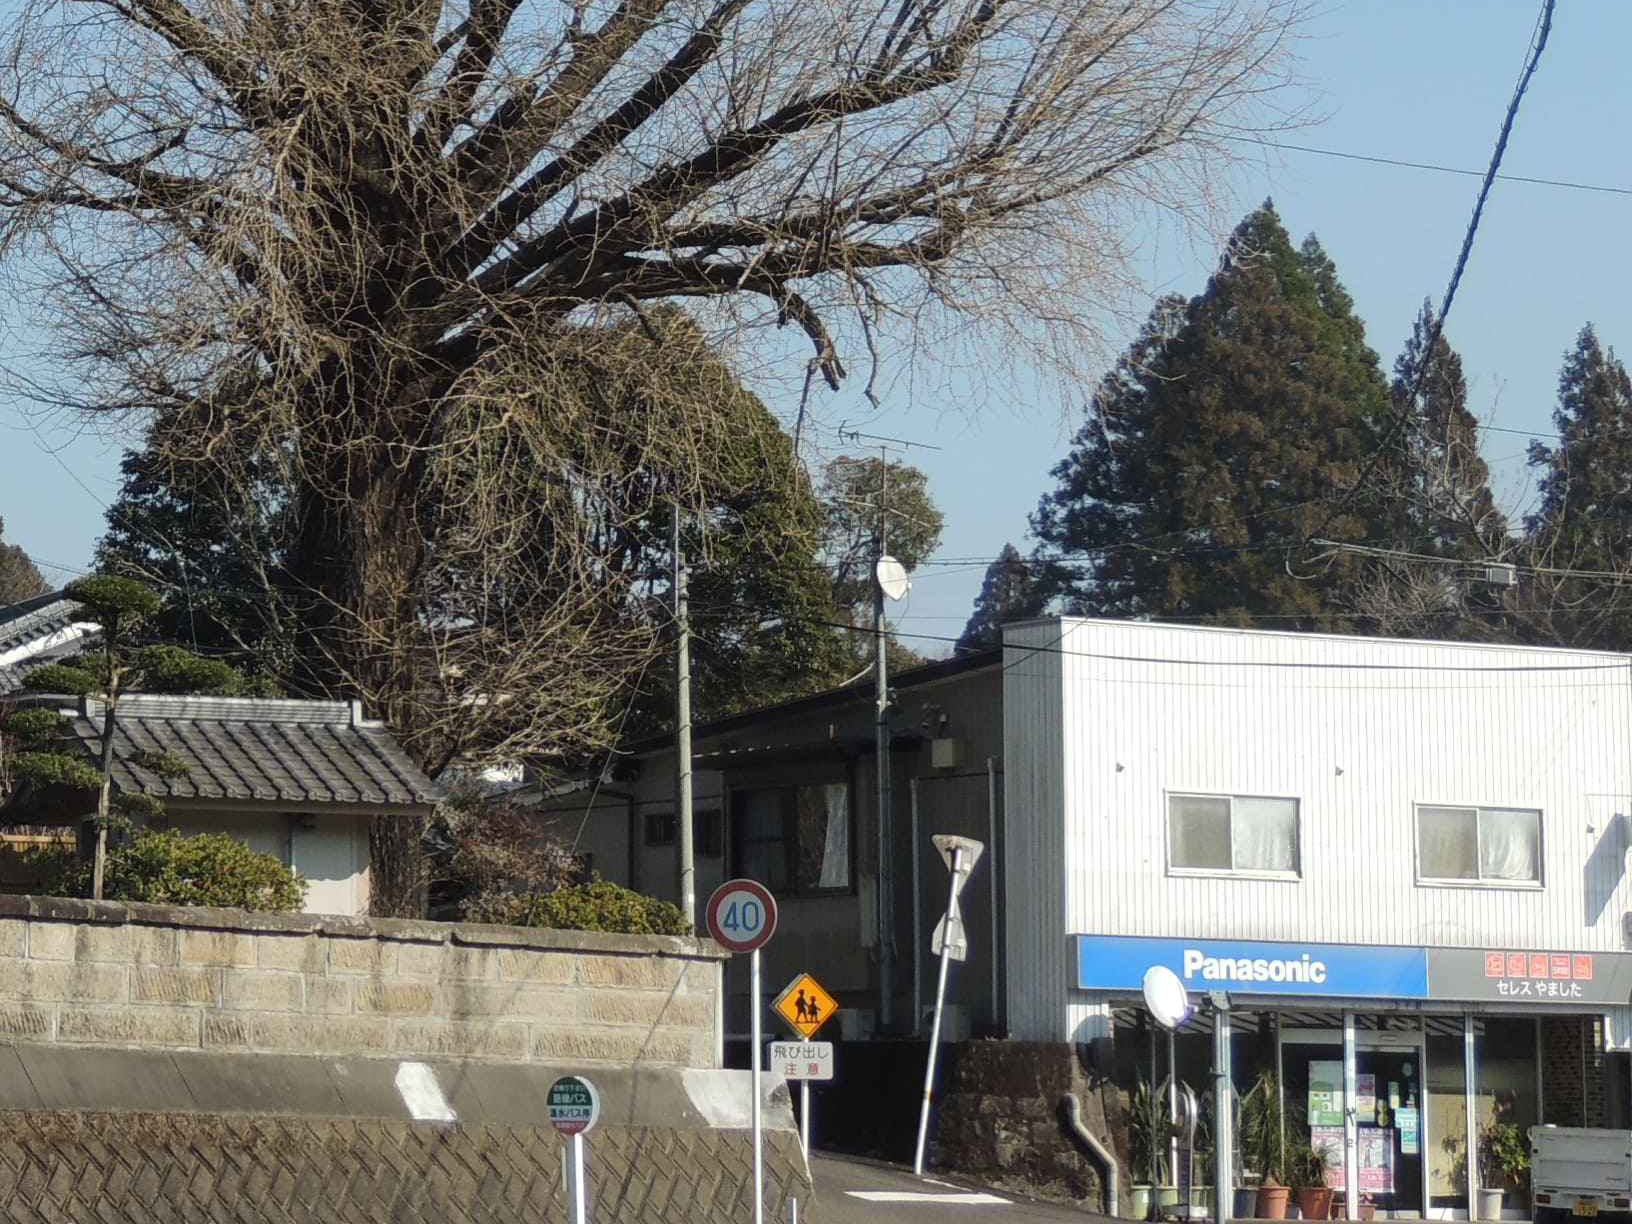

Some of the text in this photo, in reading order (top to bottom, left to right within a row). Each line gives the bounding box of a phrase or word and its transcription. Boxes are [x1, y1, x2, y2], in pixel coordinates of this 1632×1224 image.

[723, 901, 760, 932] 40
[1183, 949, 1326, 984] Panasonic
[1497, 979, 1583, 997] セレス やました
[774, 1045, 830, 1060] 飛び出し
[784, 1061, 820, 1076] 注意
